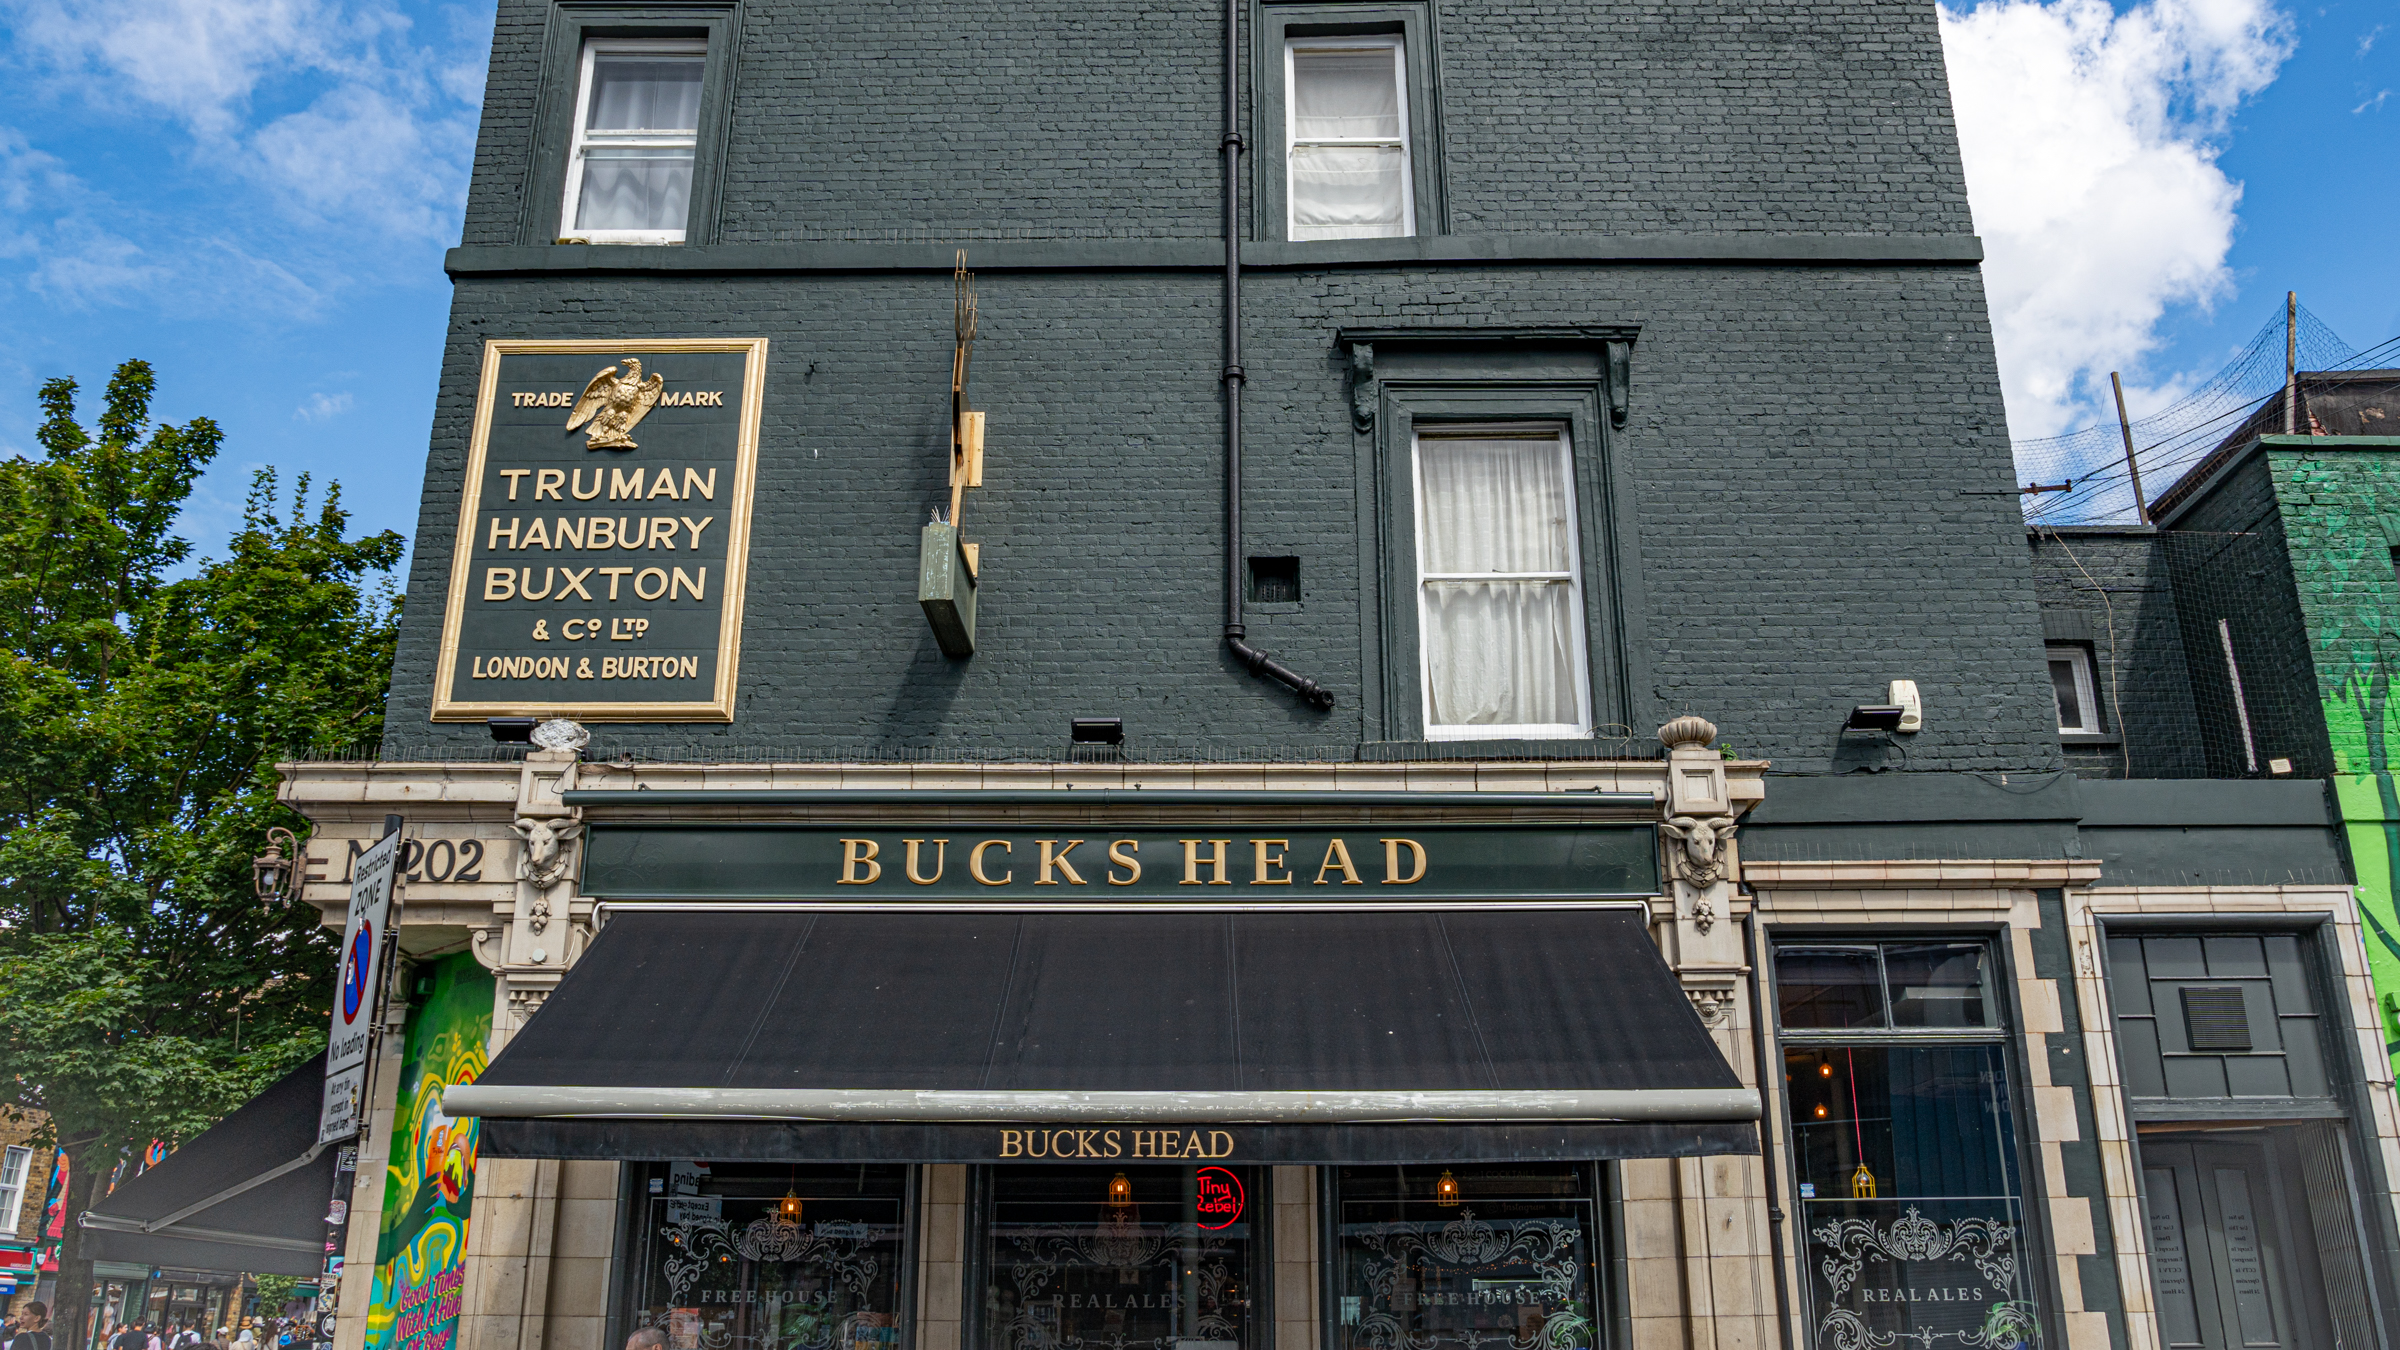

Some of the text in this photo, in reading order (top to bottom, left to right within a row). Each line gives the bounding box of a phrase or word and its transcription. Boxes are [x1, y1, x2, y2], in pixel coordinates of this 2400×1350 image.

[512, 391, 723, 408] TRADE MARK
[500, 467, 717, 500] TRUMAN
[488, 516, 713, 550] HANBURY
[484, 567, 707, 601] BUXTON
[532, 619, 550, 641] &
[472, 656, 698, 679] LONDON & BURTON
[355, 843, 392, 885] Restricted
[837, 838, 1427, 886] BUCKS HEAD
[354, 877, 382, 917] ZONE
[330, 1031, 365, 1062] No loading
[999, 1130, 1234, 1158] BUCKS HEAD
[1197, 1177, 1231, 1201] Tiny
[400, 1262, 465, 1313] Good Times
[701, 1290, 838, 1303] FREE HOUSE
[1052, 1294, 1187, 1308] REAL ALES
[1404, 1292, 1540, 1305] FREE HOUSE
[1862, 1287, 1983, 1302] REAL ALES
[396, 1306, 424, 1342] With
[424, 1300, 437, 1331] A
